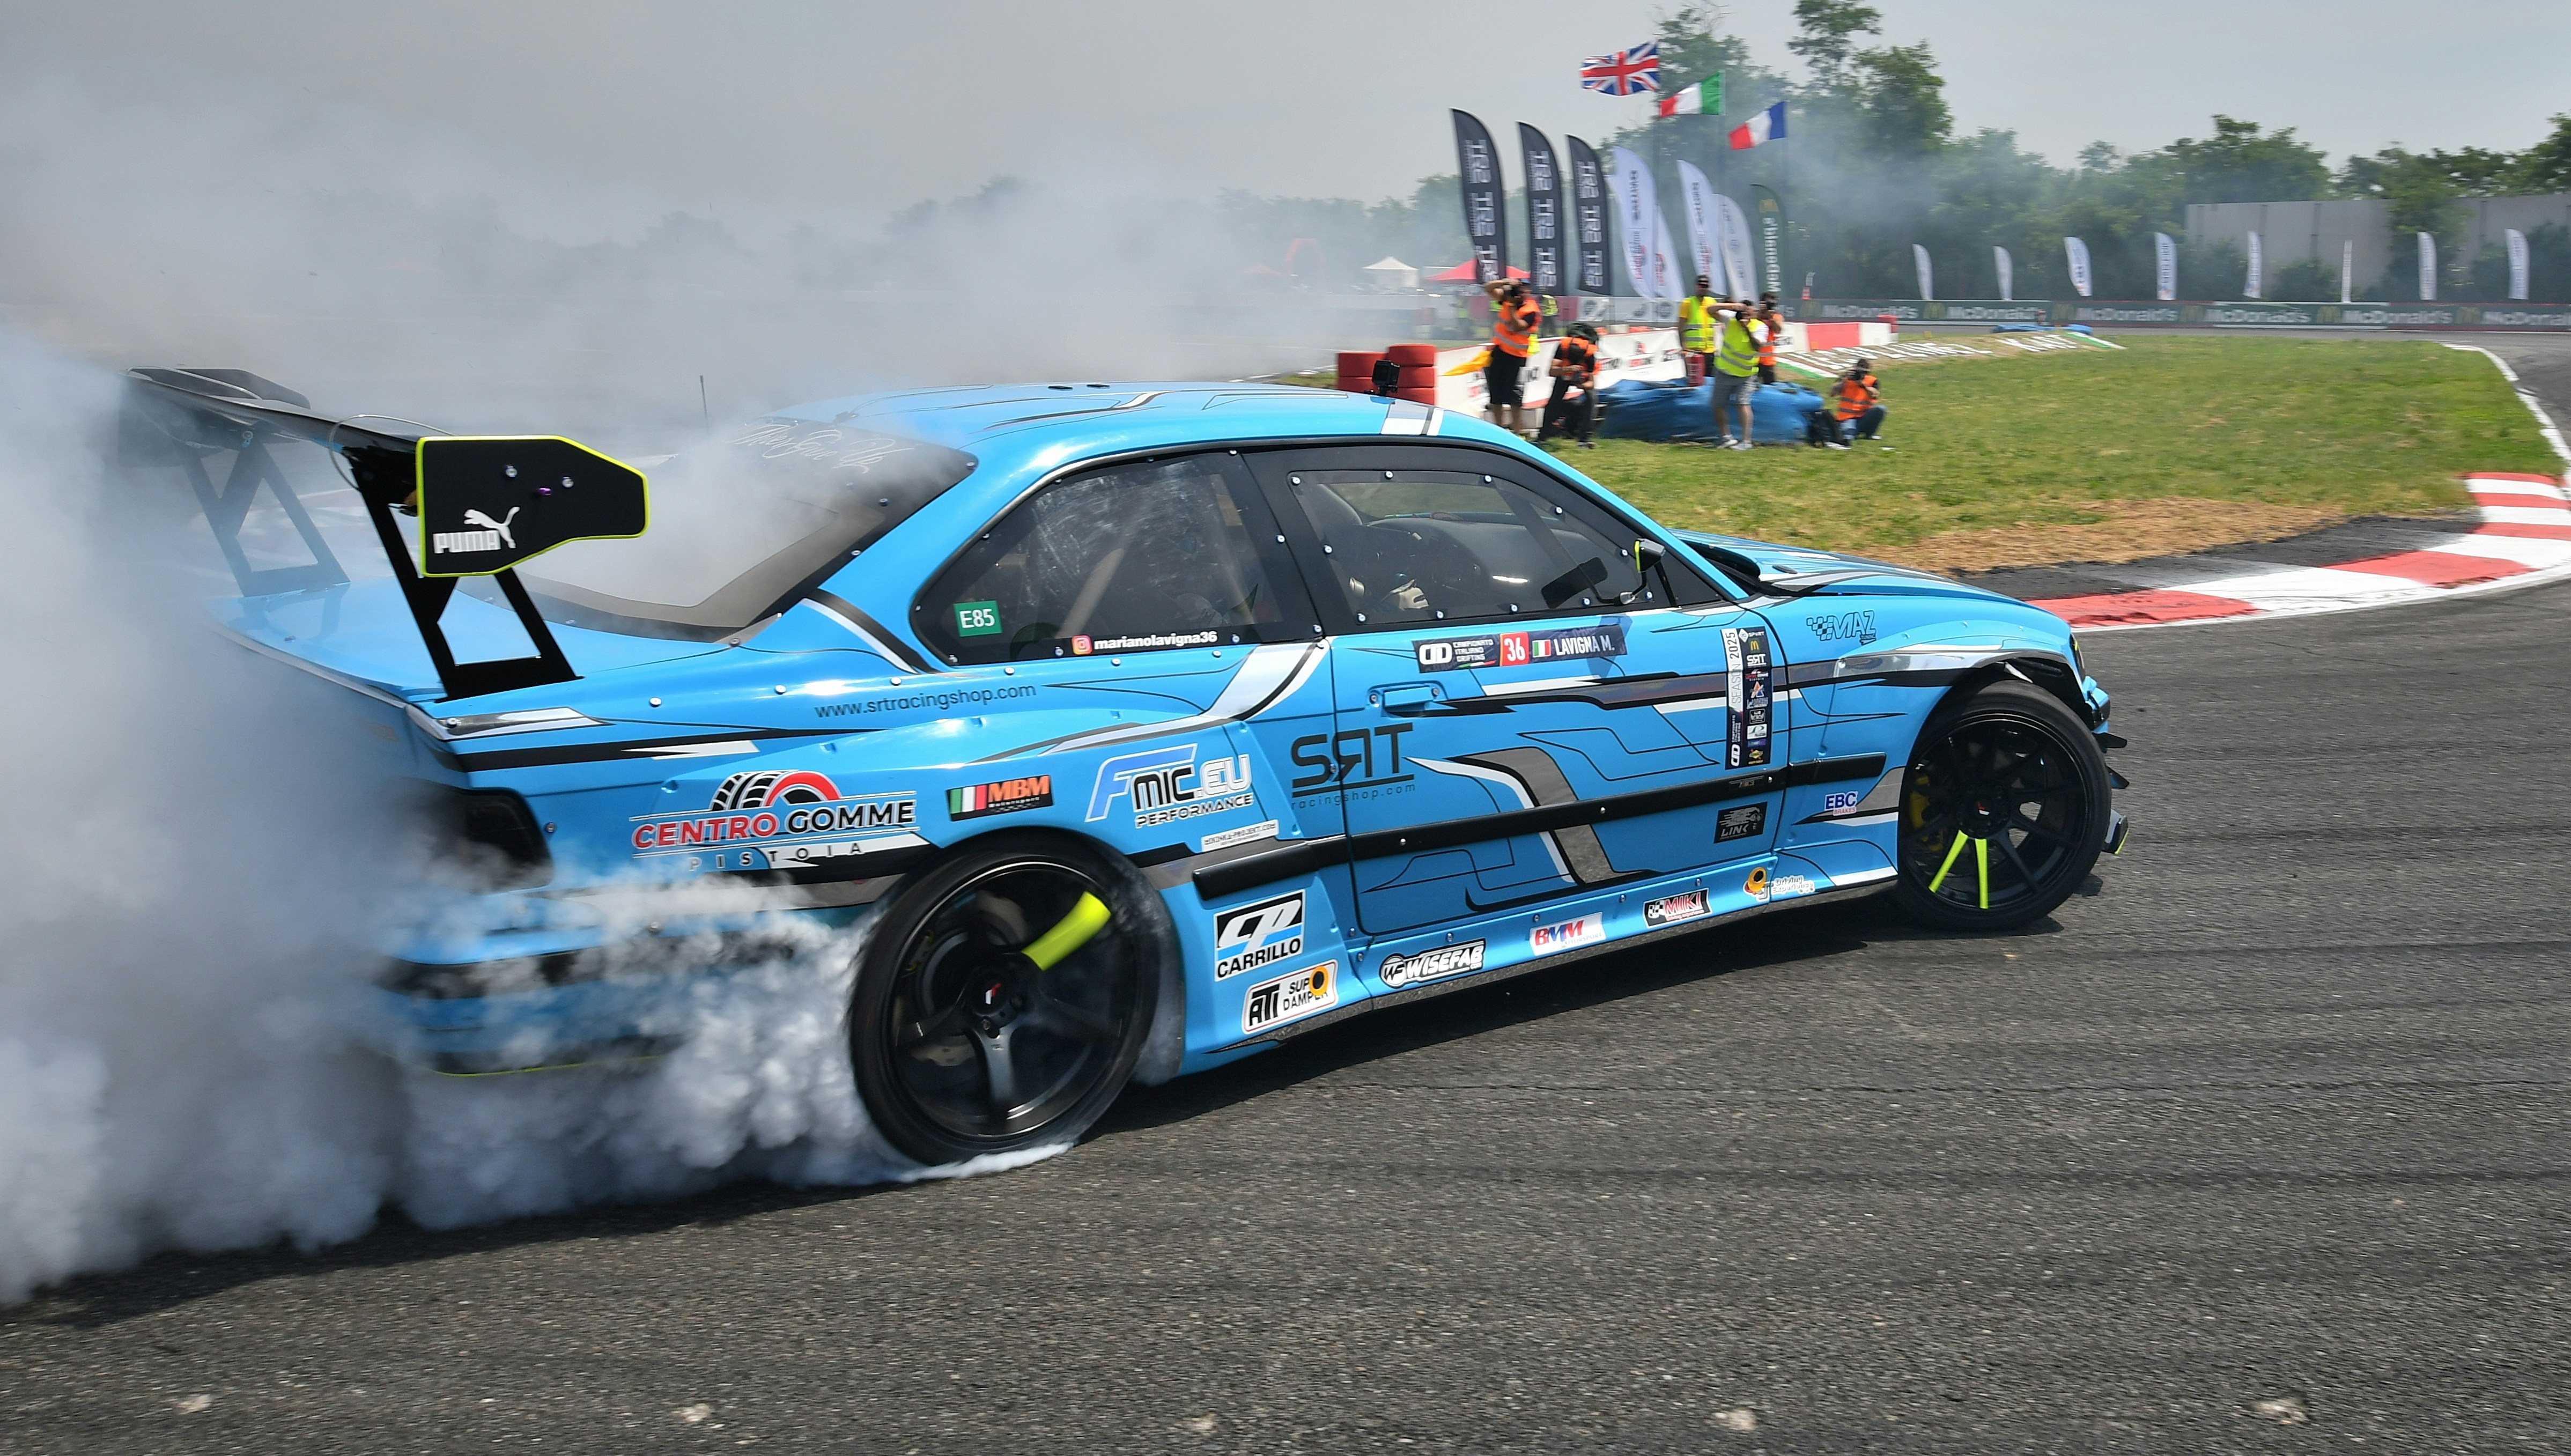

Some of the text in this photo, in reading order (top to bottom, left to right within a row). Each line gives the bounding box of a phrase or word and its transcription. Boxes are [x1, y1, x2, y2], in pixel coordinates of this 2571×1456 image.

[433, 530, 501, 553] PUMA
[959, 609, 996, 629] E85
[1094, 631, 1218, 651] marianolavigna36
[1504, 637, 1526, 662] 36
[1554, 634, 1616, 656] LAVIGNA M.
[1725, 632, 1742, 704] SEASON 2025
[814, 684, 1037, 719] www.srtracingshop.com
[988, 775, 1050, 803] MBM
[1290, 782, 1416, 810] racingshop.com
[1826, 792, 1857, 810] EBC
[1134, 793, 1255, 829] PERFORMANCE
[632, 800, 917, 850] CENTRO GOMME
[1720, 824, 1749, 837] LINK
[689, 842, 866, 871] PISTOIA
[1665, 892, 1701, 914] MIKI
[1535, 919, 1585, 946] BMM
[1217, 938, 1302, 980] CARRILLO
[1407, 945, 1484, 979] WISEFAB
[1289, 977, 1311, 995] SUP
[1249, 982, 1281, 1026] ATI
